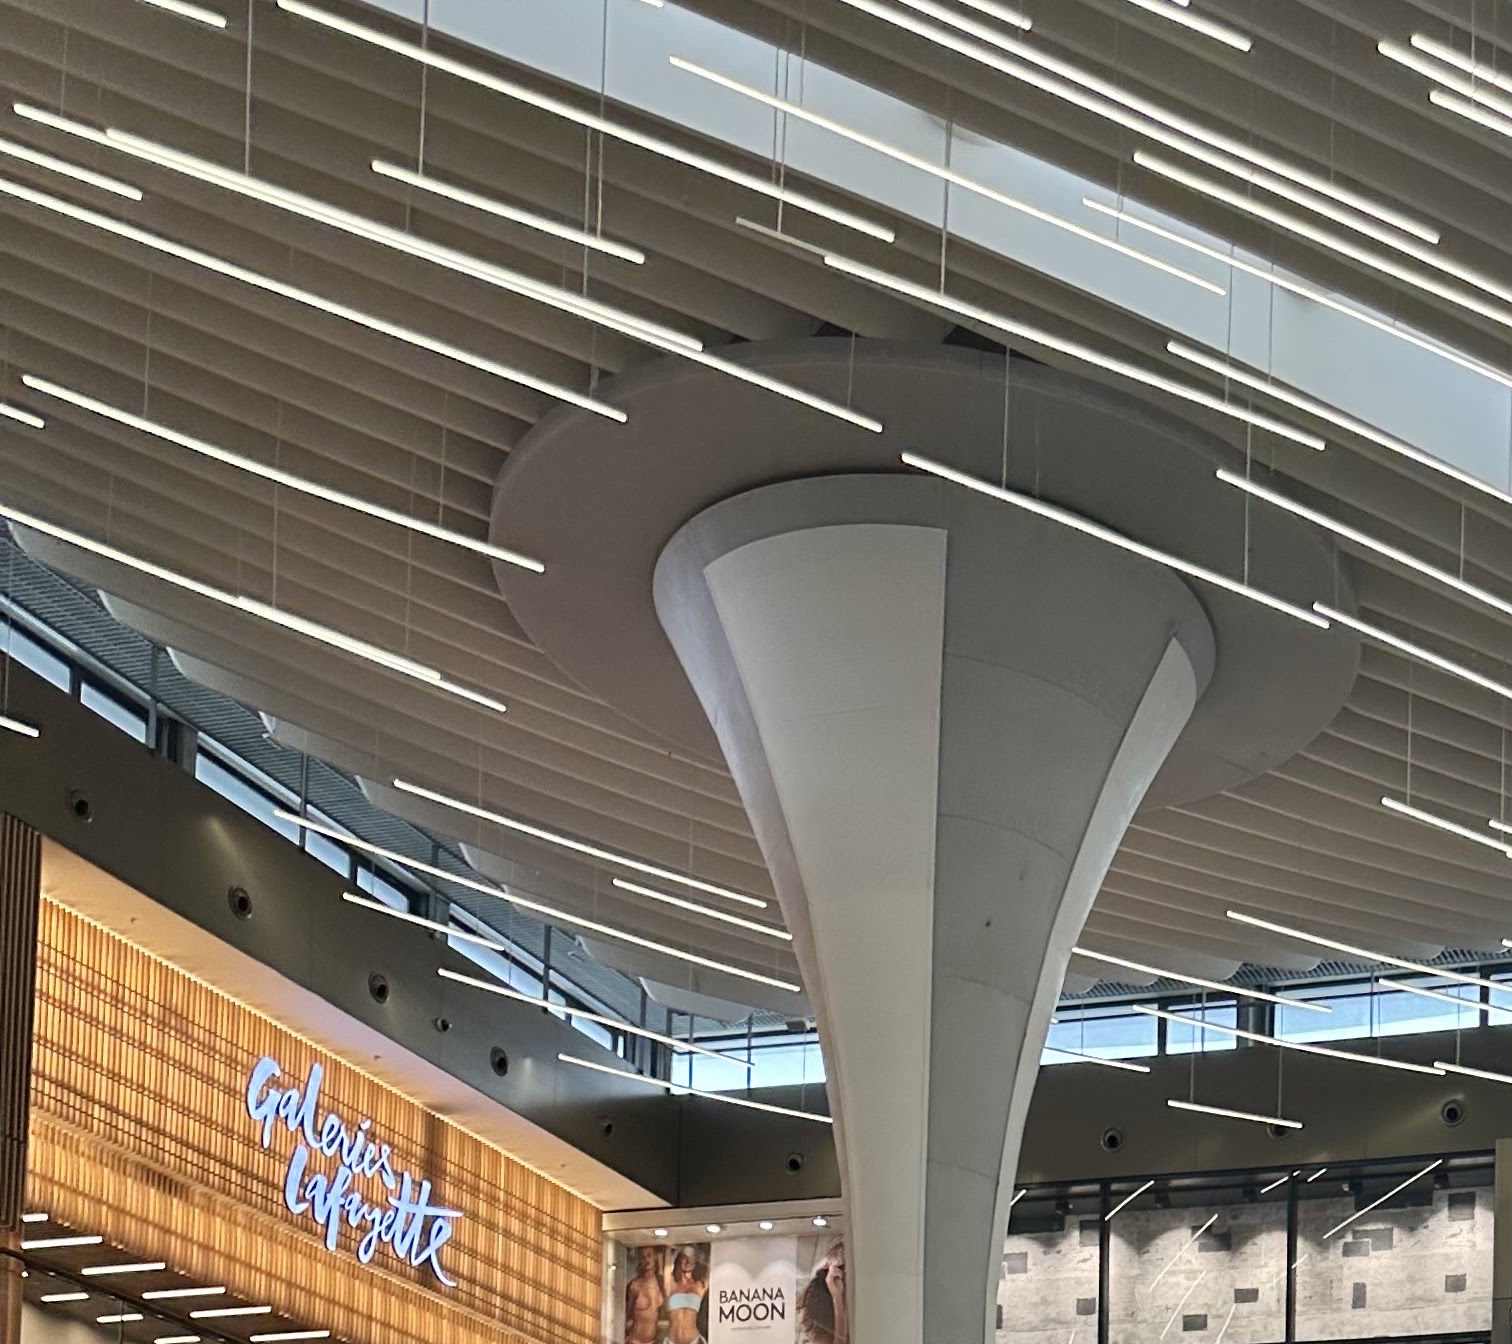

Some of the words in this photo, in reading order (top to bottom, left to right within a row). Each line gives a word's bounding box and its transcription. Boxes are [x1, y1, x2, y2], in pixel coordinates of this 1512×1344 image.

[247, 1056, 396, 1190] Galeries
[285, 1144, 464, 1287] Lafayette
[719, 1287, 785, 1304] BANANA
[719, 1302, 786, 1323] MOON
